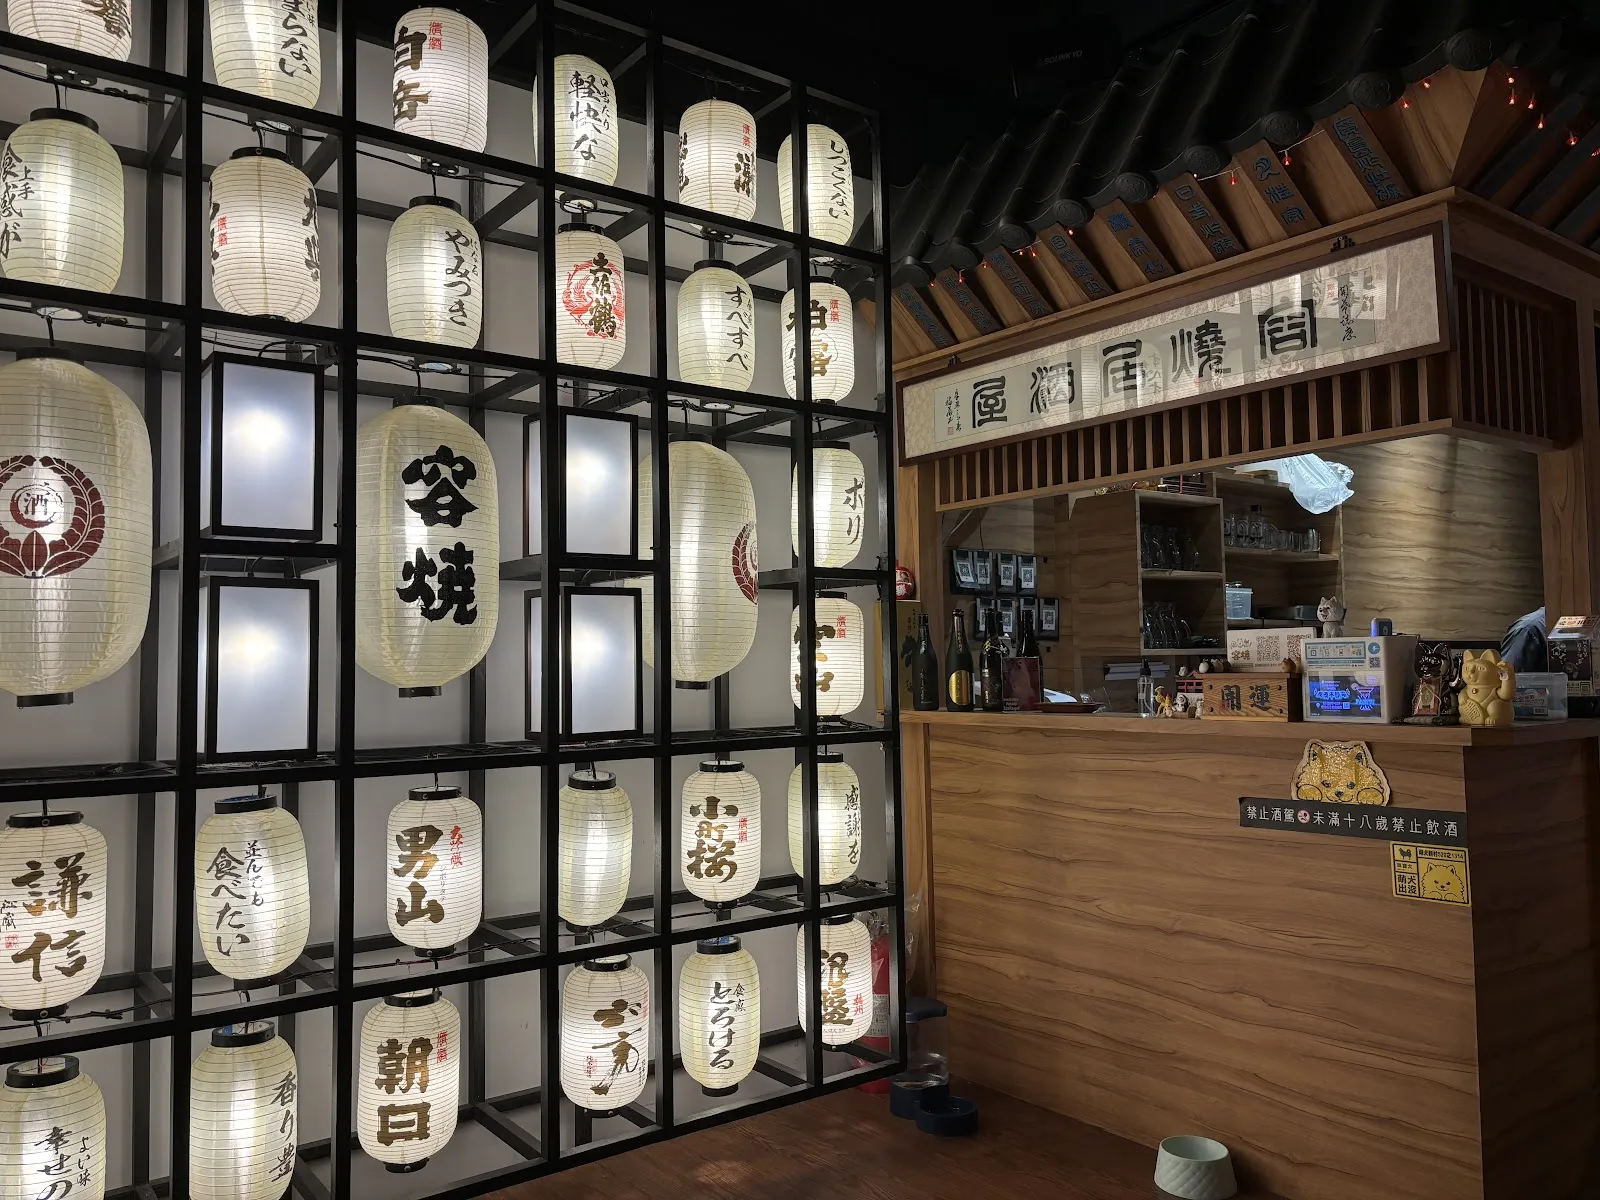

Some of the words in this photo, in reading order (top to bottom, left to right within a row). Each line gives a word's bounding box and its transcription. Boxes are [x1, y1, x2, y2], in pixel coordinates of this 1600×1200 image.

[443, 229, 472, 326] やみつき
[725, 286, 749, 371] すべすべ
[1246, 805, 1295, 823] 禁止酒駕
[1312, 809, 1459, 838] 未滿十八歲禁止飲酒
[11, 851, 93, 983] 謙信
[206, 846, 251, 957] 食べたい
[391, 824, 445, 927] 男山
[709, 982, 736, 1070] とろける
[375, 1037, 433, 1146] 朝日
